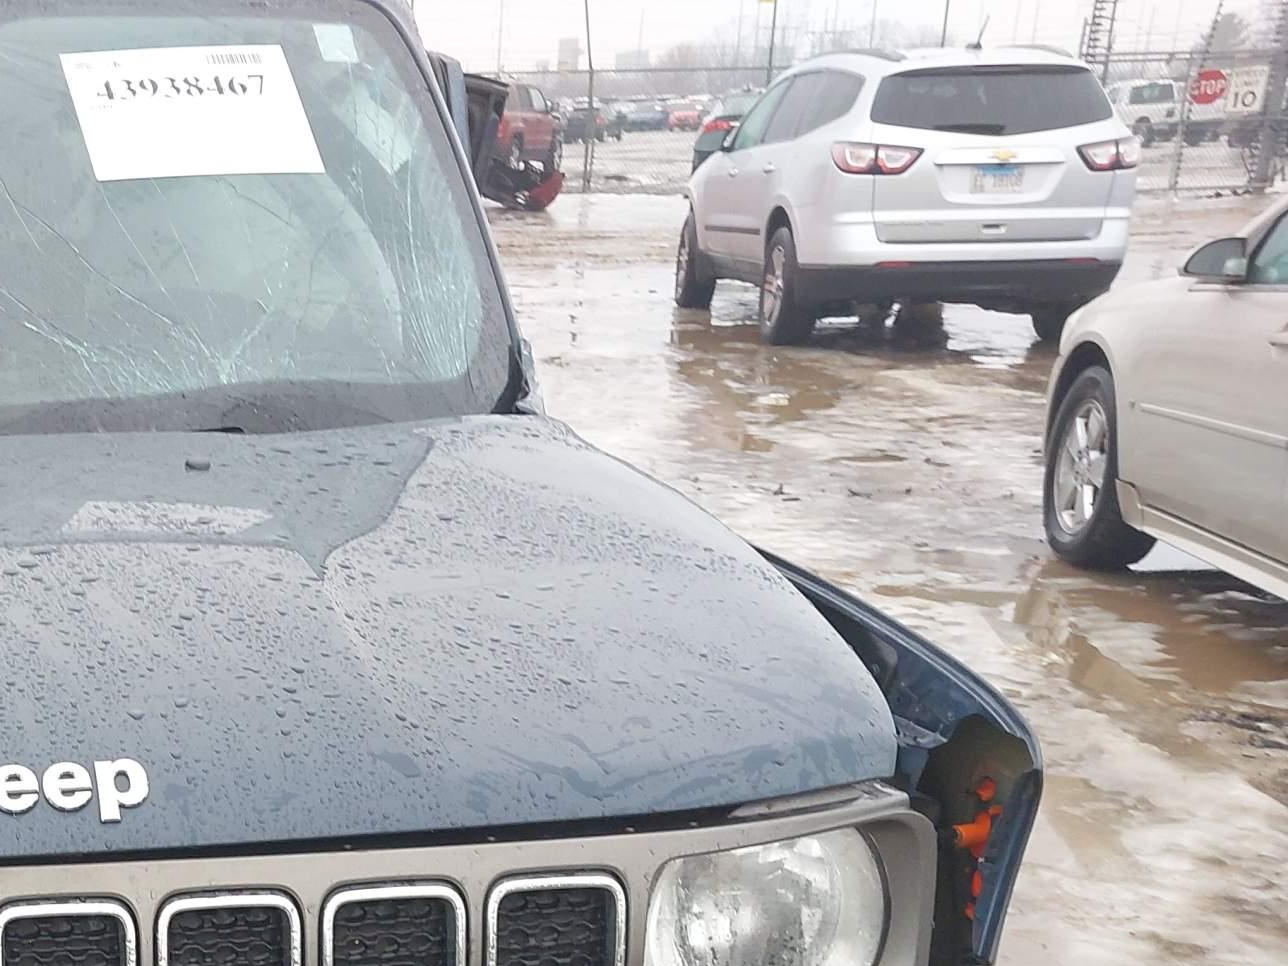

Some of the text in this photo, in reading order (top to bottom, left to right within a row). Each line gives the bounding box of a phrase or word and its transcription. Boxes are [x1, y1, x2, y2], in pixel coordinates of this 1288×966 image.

[97, 74, 264, 100] 43938467
[1190, 79, 1226, 95] STOP
[1233, 90, 1257, 108] 10
